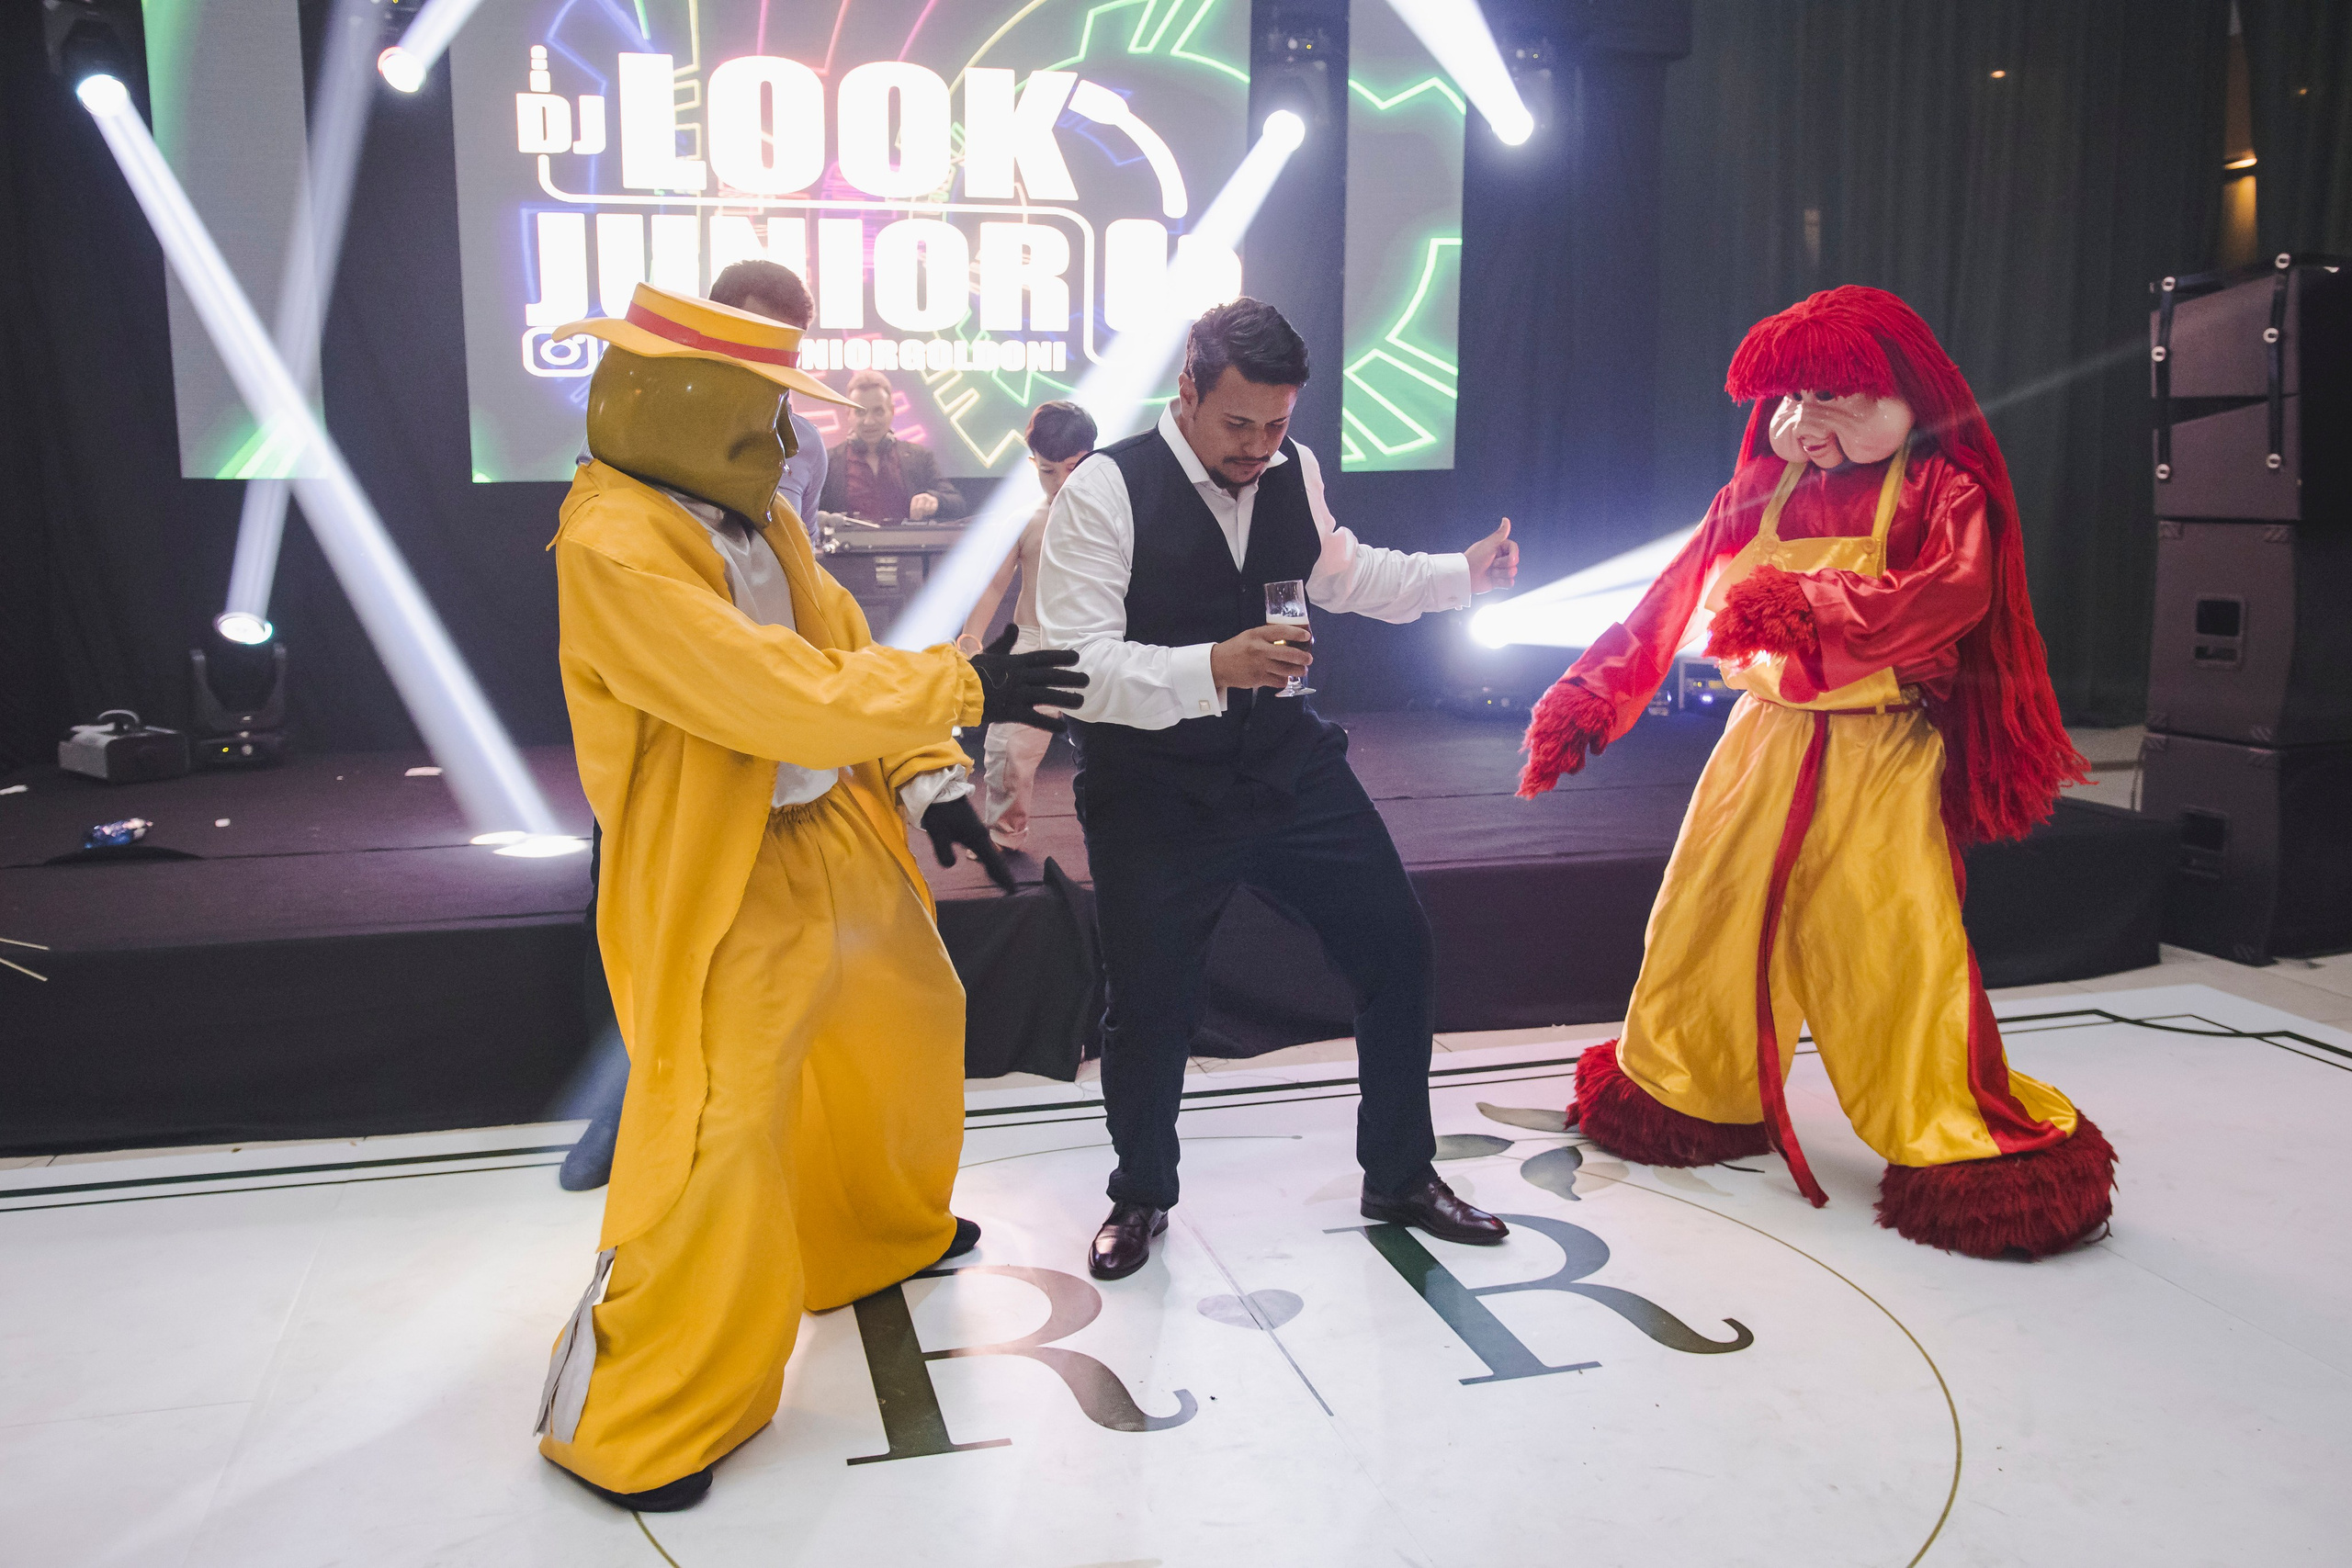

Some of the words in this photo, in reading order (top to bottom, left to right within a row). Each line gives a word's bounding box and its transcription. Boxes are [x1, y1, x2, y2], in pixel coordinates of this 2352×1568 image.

[516, 93, 605, 154] DJ
[618, 52, 1078, 200] LOOK
[846, 1265, 1198, 1466] R
[1321, 1213, 1754, 1385] R
